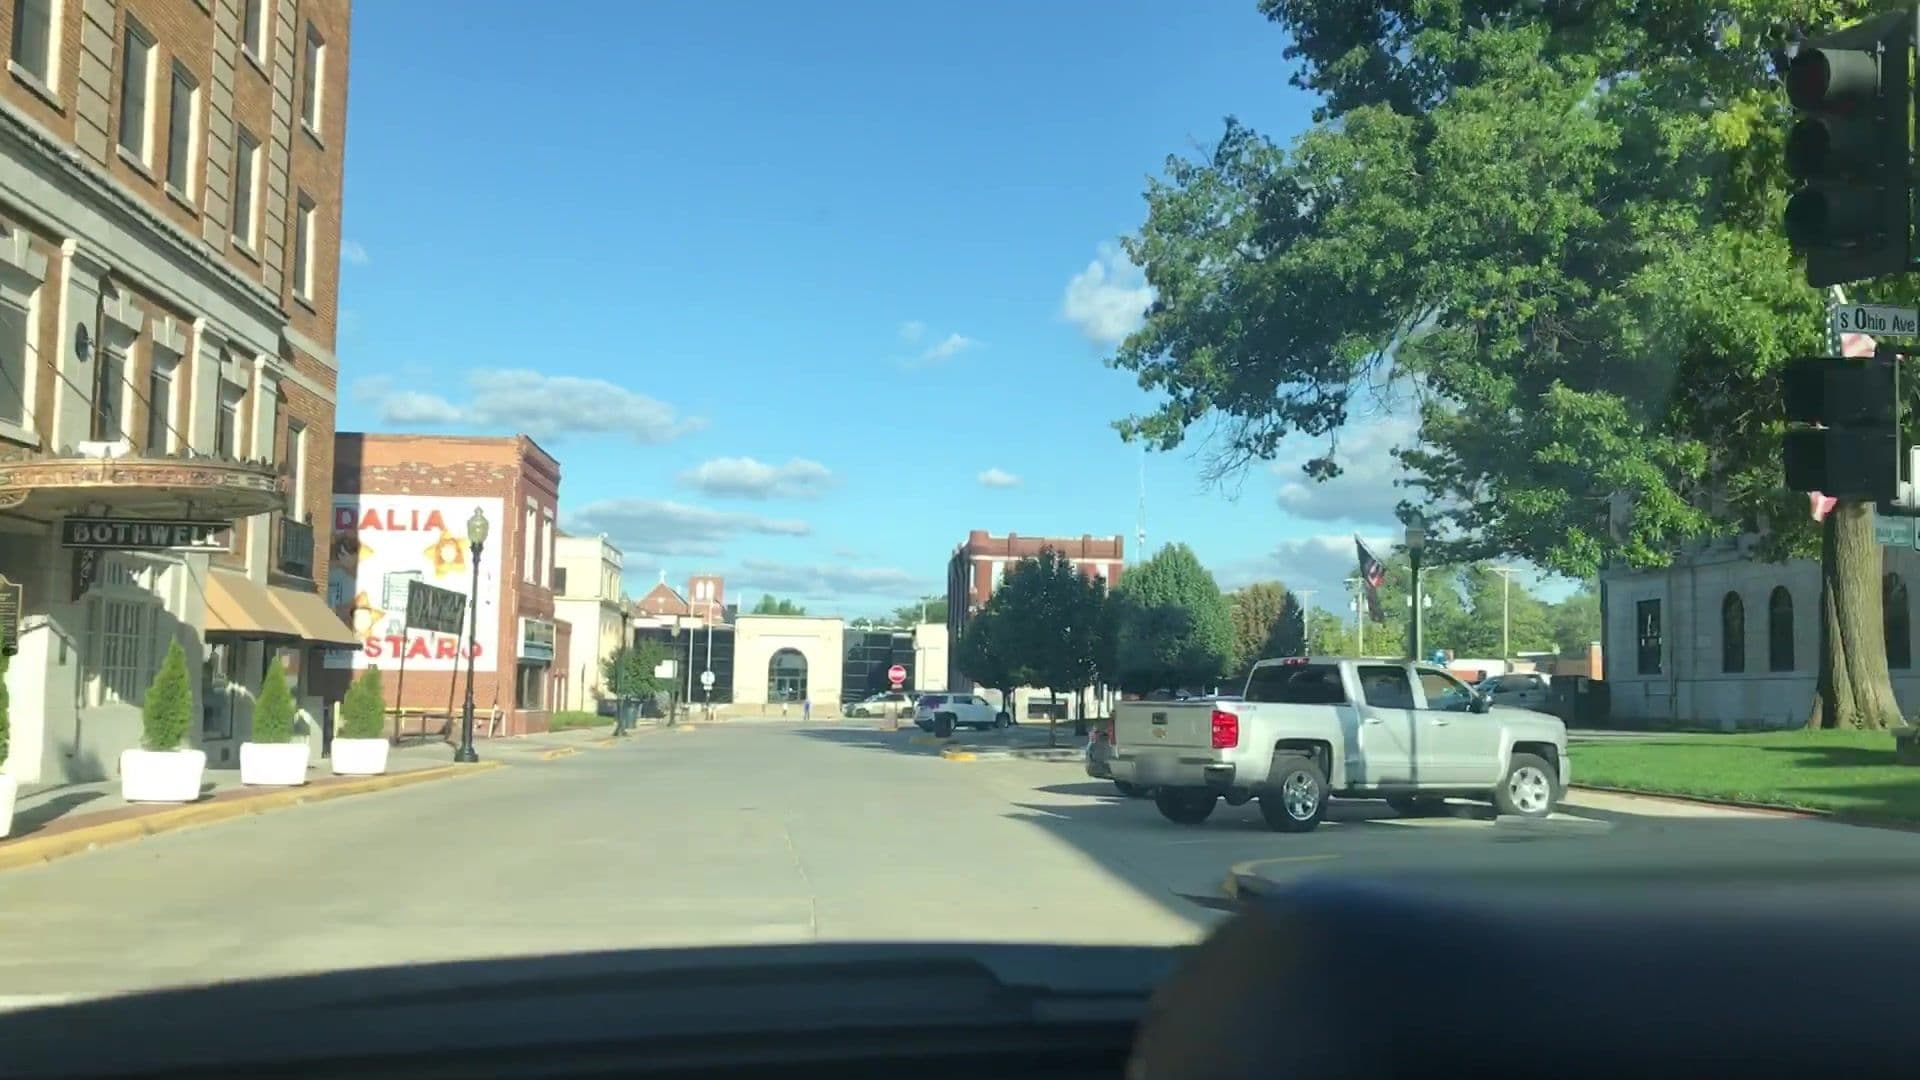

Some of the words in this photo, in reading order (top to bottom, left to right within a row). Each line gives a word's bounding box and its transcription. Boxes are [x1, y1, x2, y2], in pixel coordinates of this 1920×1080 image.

[1841, 312, 1849, 329] S
[1855, 308, 1886, 331] Ohio
[1892, 315, 1915, 332] Ave
[335, 507, 445, 531] DALIA
[74, 523, 220, 546] BOTHWELL
